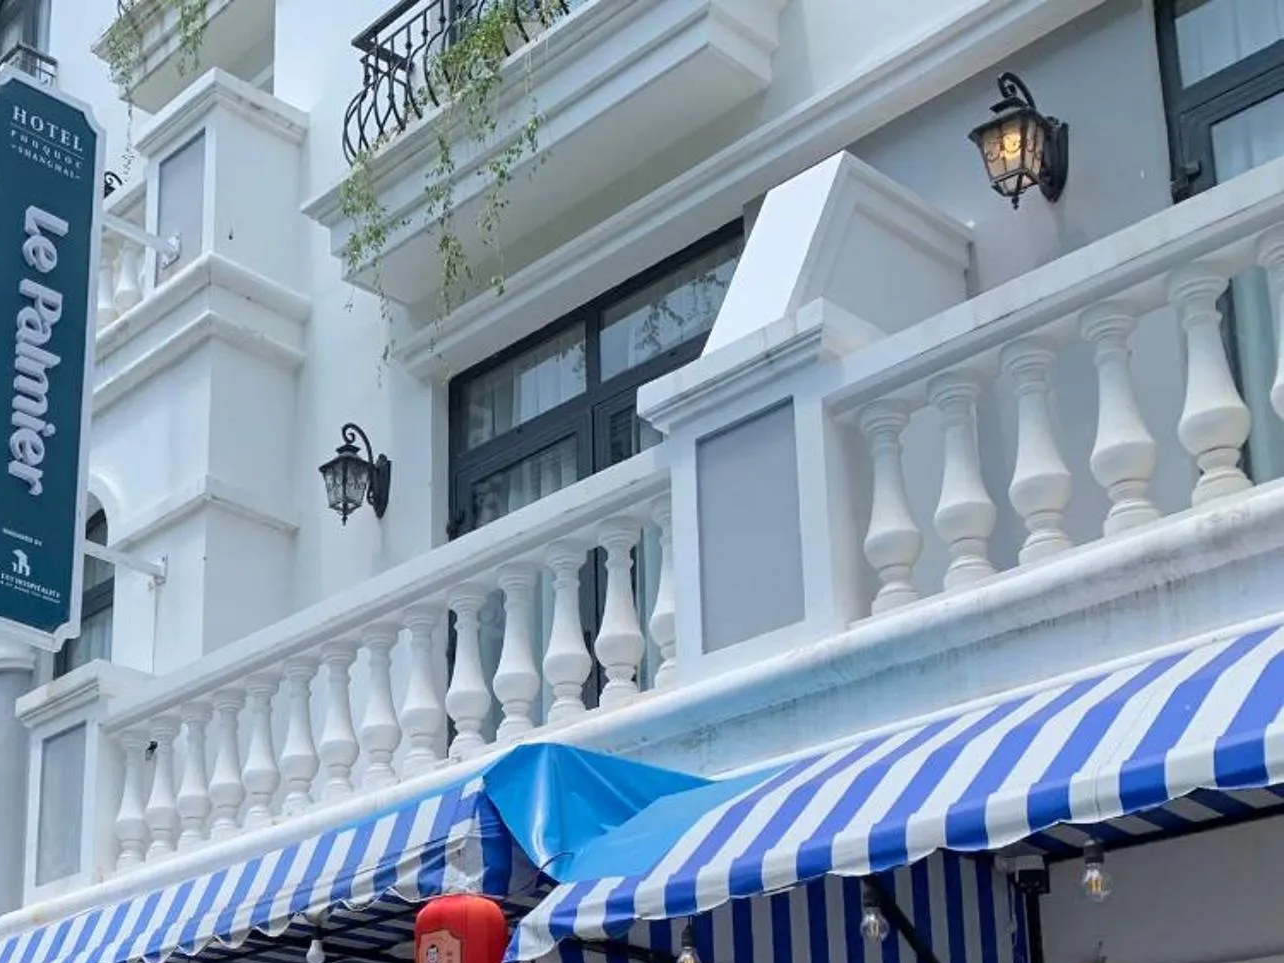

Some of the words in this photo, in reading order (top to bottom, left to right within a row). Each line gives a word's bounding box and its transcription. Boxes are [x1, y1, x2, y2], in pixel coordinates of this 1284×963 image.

[12, 105, 83, 152] HOTEL
[22, 205, 69, 273] Le
[8, 278, 64, 495] Palmier
